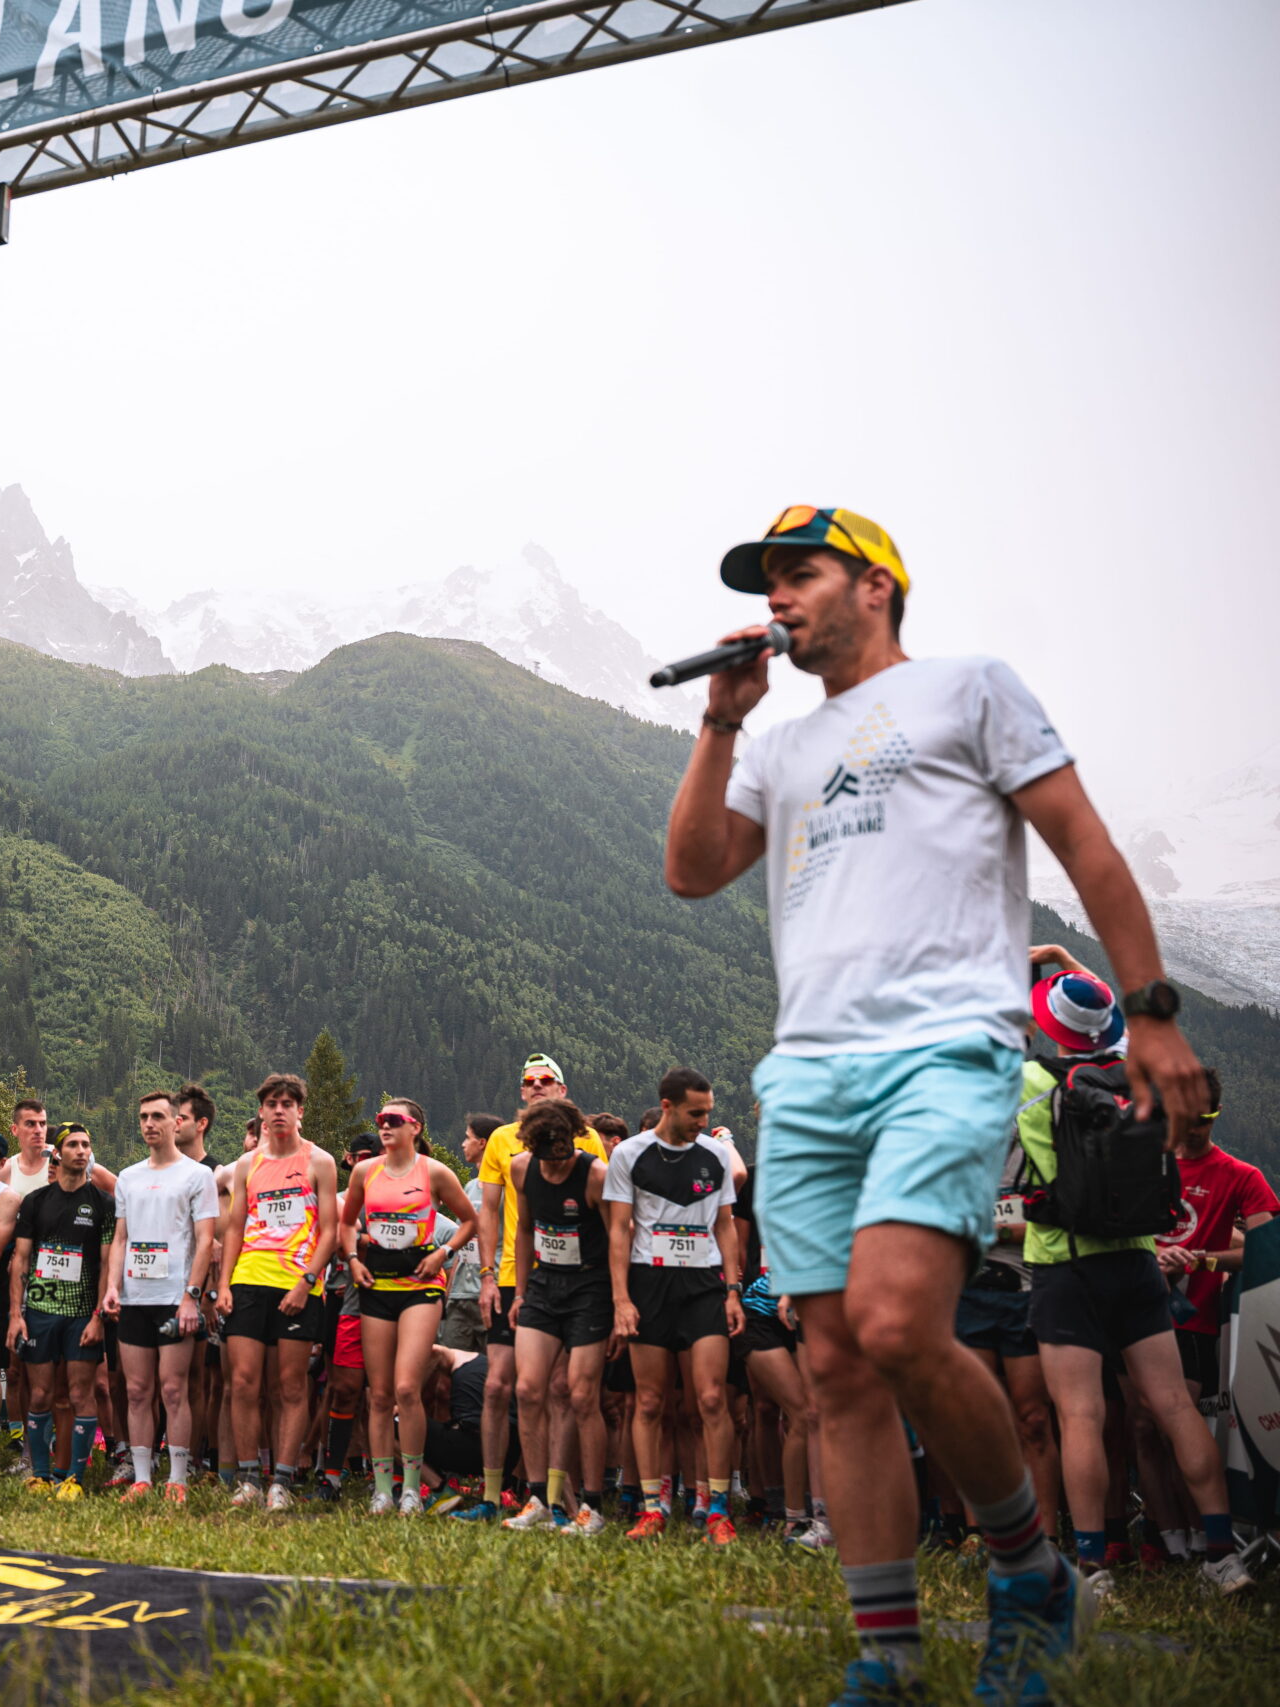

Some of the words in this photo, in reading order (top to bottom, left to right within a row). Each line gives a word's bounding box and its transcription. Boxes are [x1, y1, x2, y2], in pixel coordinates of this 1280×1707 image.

[267, 1200, 292, 1213] 7787
[380, 1223, 405, 1236] 7789
[540, 1236, 567, 1251] 7502
[669, 1239, 695, 1251] 7511
[46, 1255, 70, 1268] 7541
[133, 1254, 157, 1265] 7537
